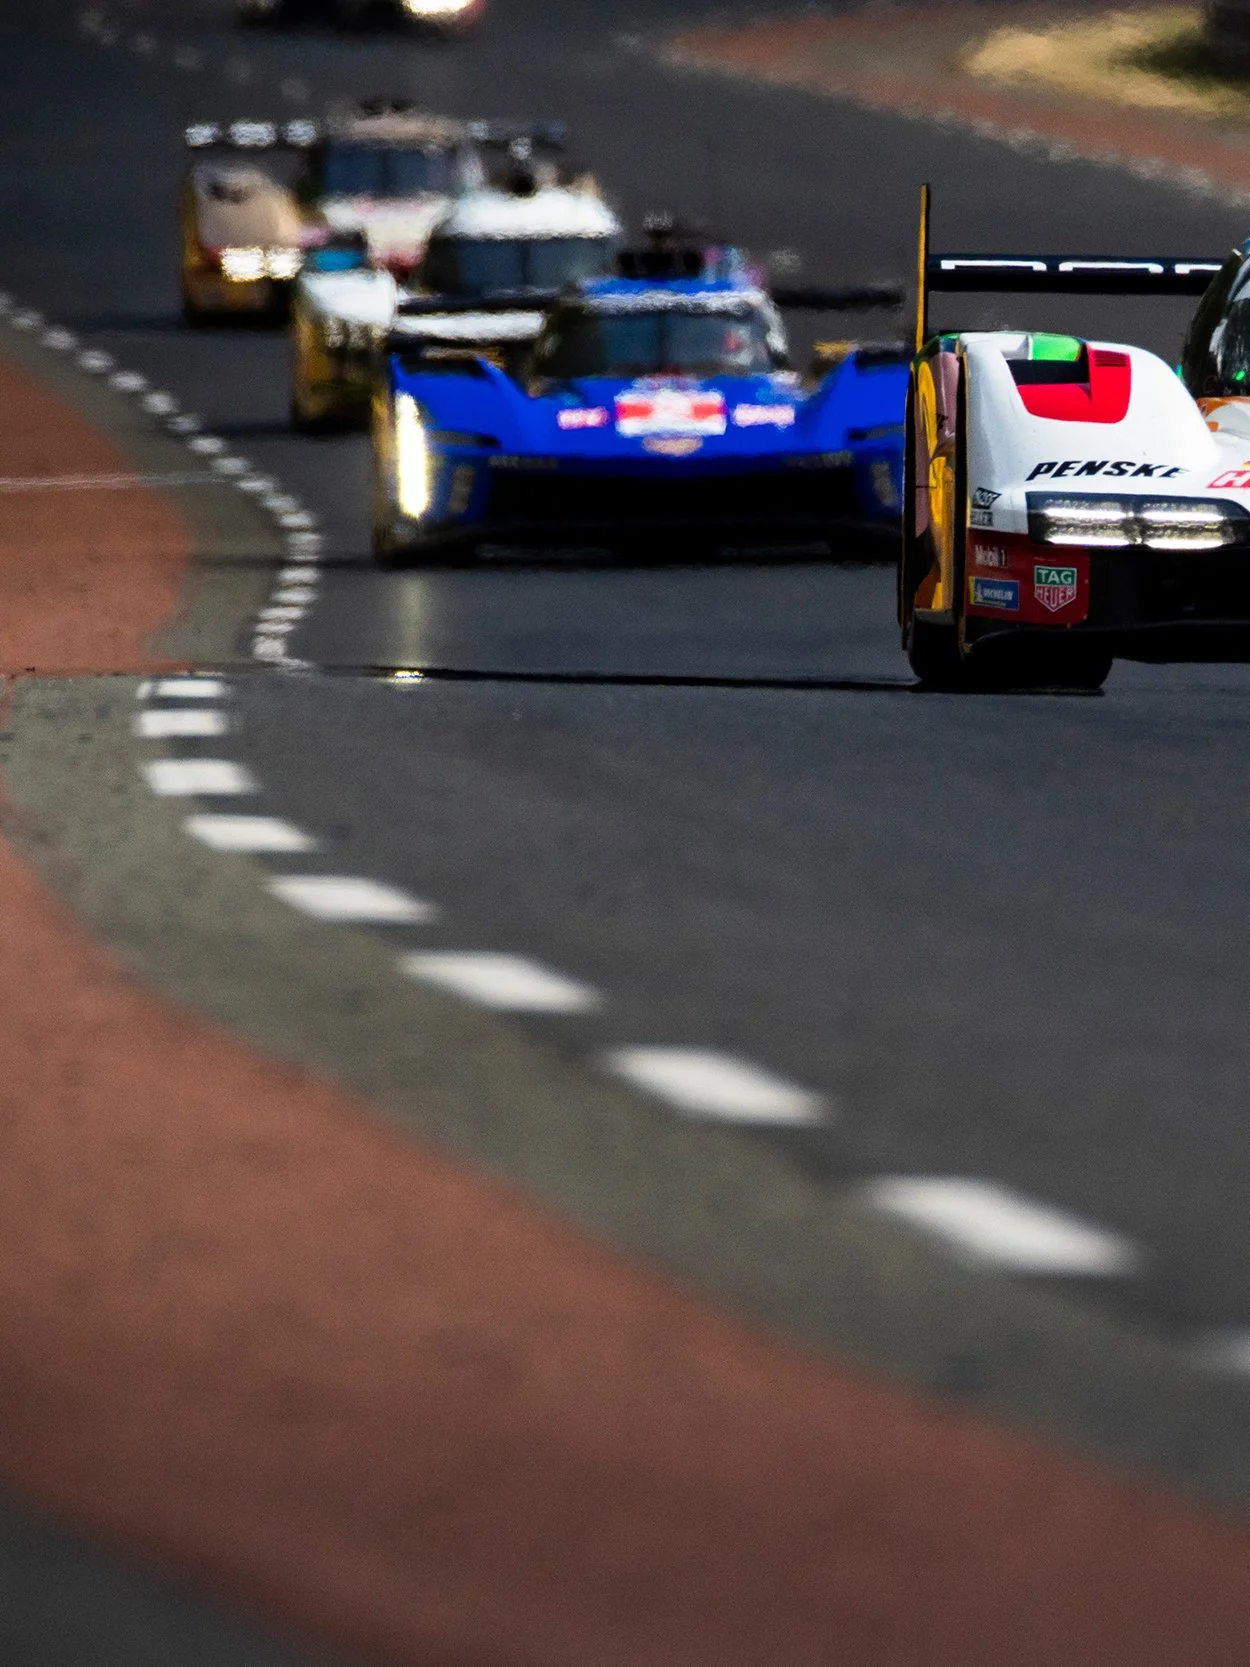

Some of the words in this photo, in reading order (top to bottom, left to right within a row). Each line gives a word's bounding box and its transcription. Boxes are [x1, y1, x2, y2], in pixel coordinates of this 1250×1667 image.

[1025, 460, 1187, 481] PENSKE
[1038, 569, 1072, 584] TAG
[1036, 585, 1075, 609] HEUER
